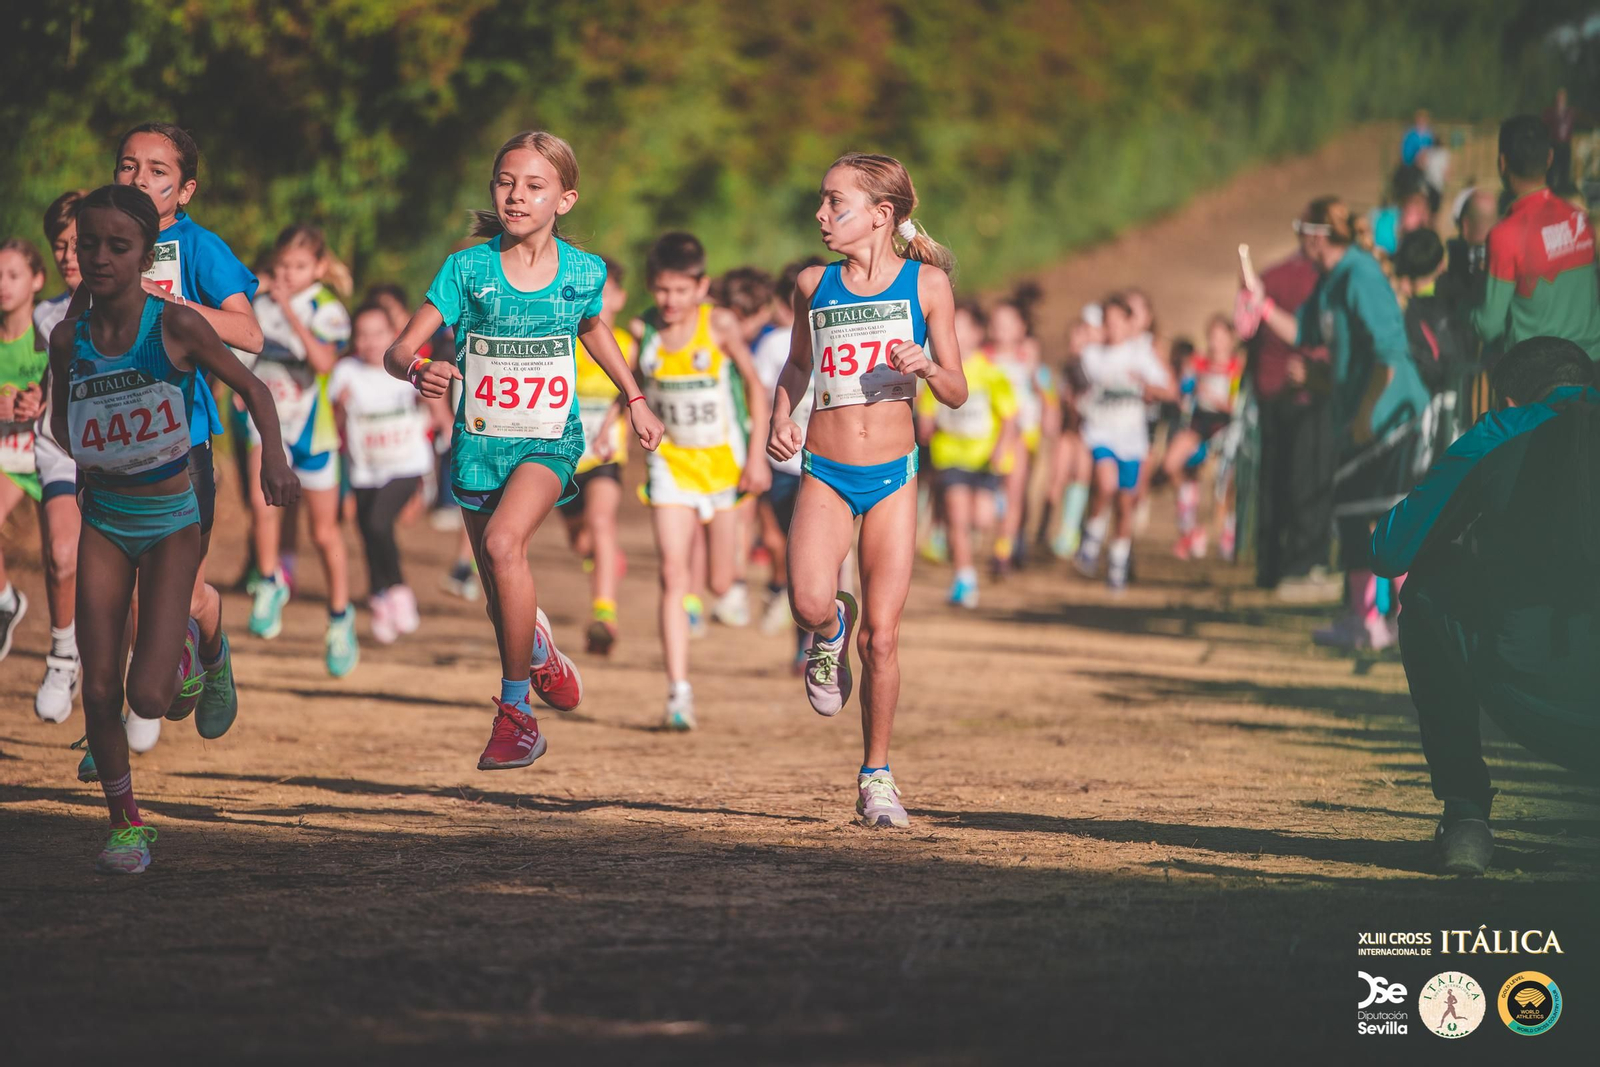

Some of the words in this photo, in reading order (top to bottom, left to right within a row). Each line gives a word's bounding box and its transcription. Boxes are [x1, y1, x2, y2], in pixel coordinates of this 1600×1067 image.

[831, 307, 882, 323] ITÁLICA
[496, 341, 548, 355] ITÁLICA
[93, 373, 146, 393] ITÁLICA
[475, 375, 569, 410] 4379
[81, 399, 181, 452] 4421
